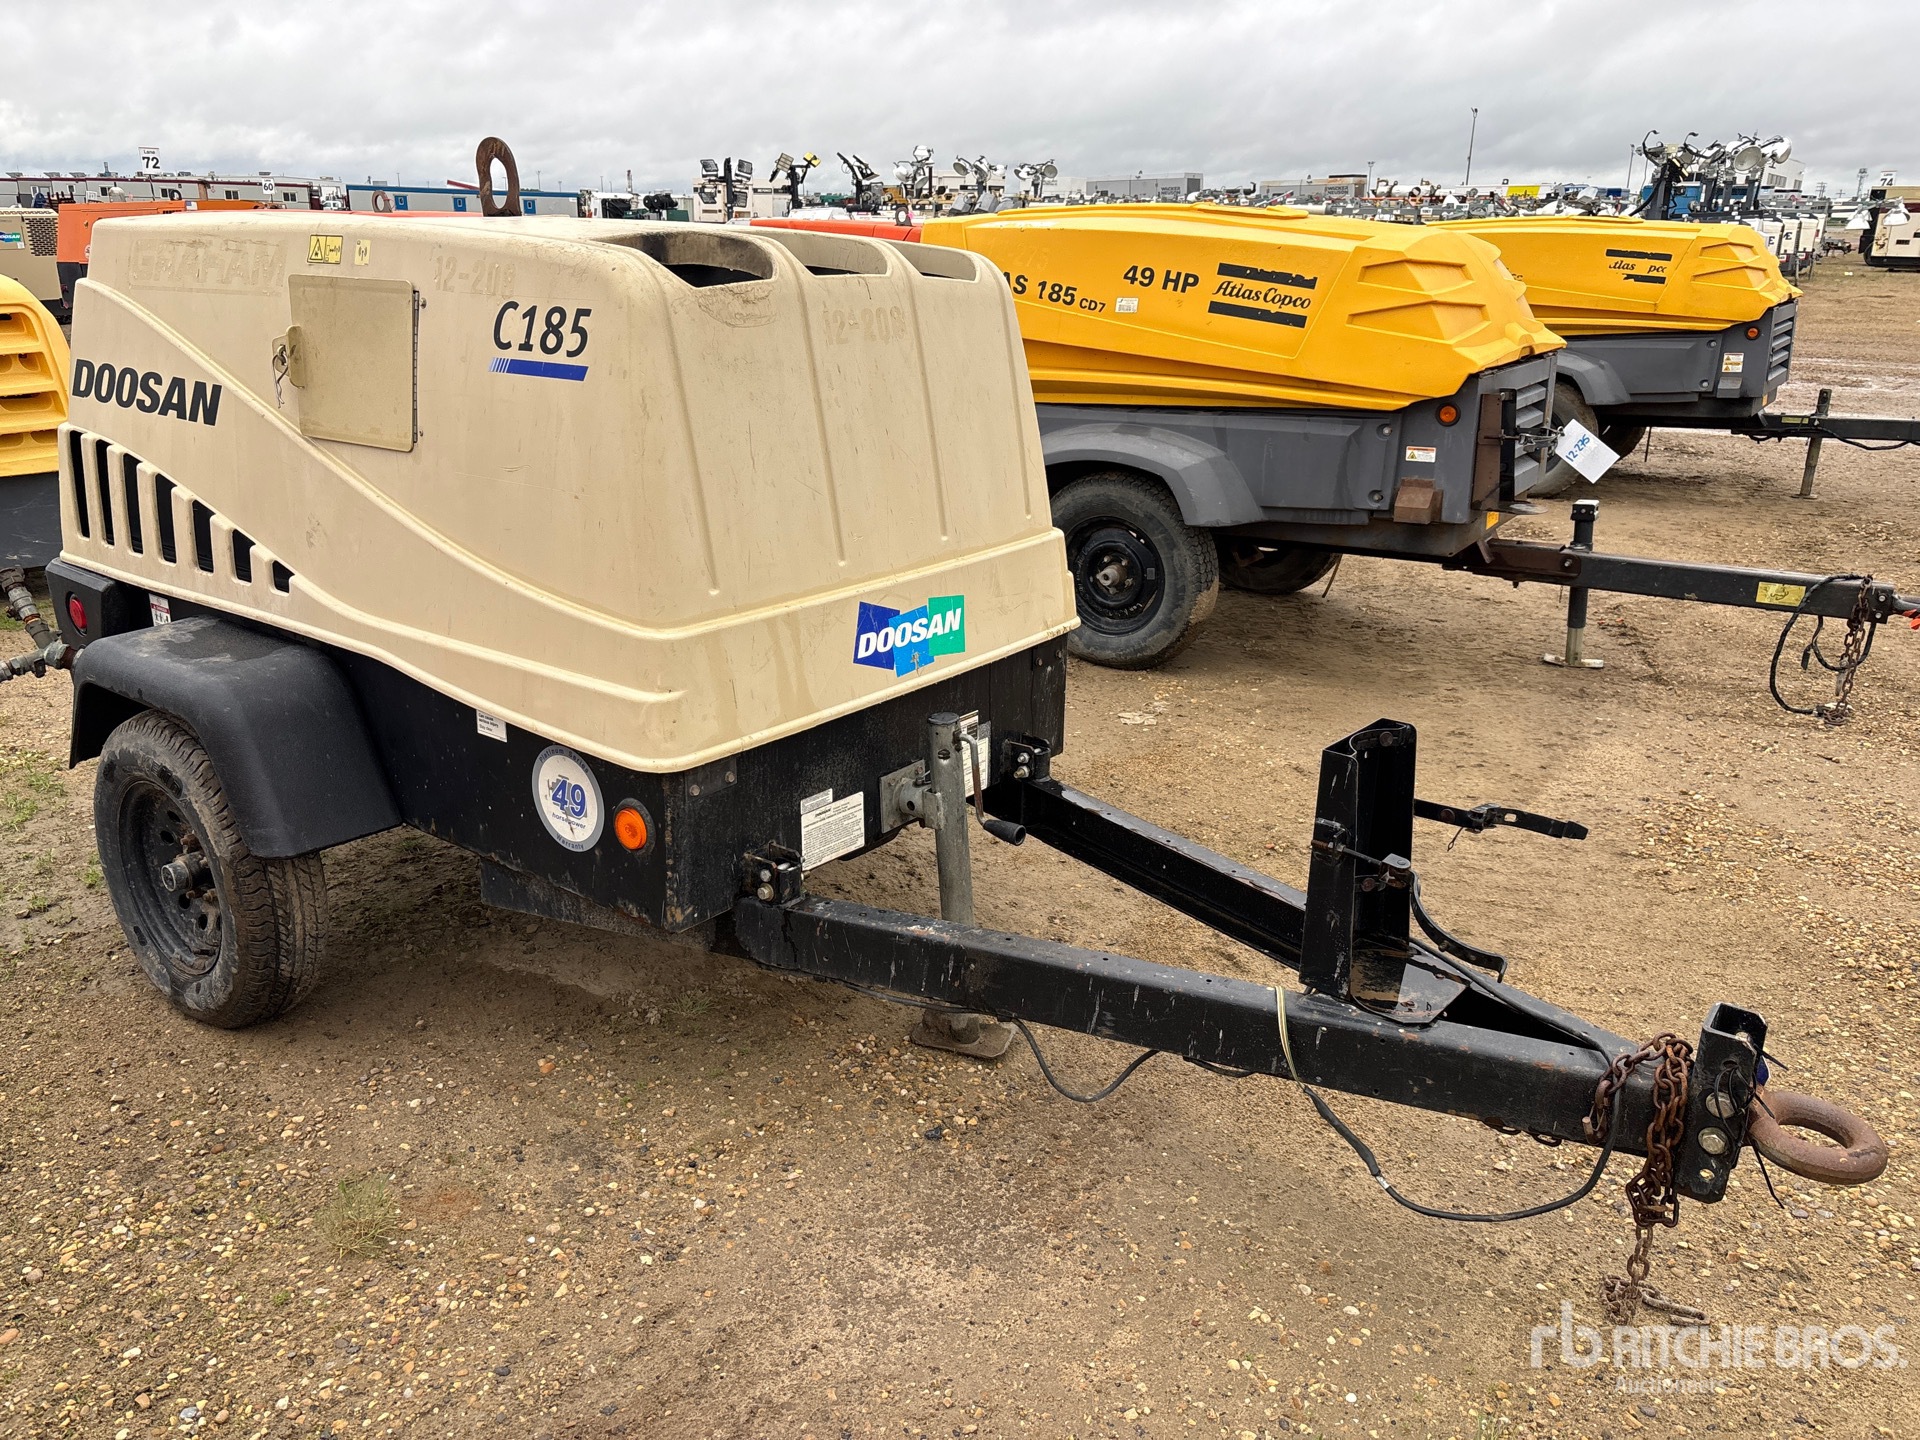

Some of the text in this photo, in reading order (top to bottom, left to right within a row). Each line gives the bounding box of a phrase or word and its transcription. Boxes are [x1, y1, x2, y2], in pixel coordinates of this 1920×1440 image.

[142, 156, 160, 169] 72
[263, 182, 274, 191] 60
[1880, 177, 1894, 186] 74
[1123, 264, 1200, 294] 49 HP
[1036, 280, 1078, 306] 185
[1079, 297, 1106, 313] CD7
[1212, 280, 1311, 309] Atlas Copco
[492, 301, 592, 359] C185
[72, 358, 222, 427] DOOSAN
[857, 607, 962, 659] DOOSAN
[539, 747, 589, 774] Platinum Series
[551, 778, 588, 819] 49
[551, 811, 587, 830] horsepower
[556, 832, 585, 851] Warranty
